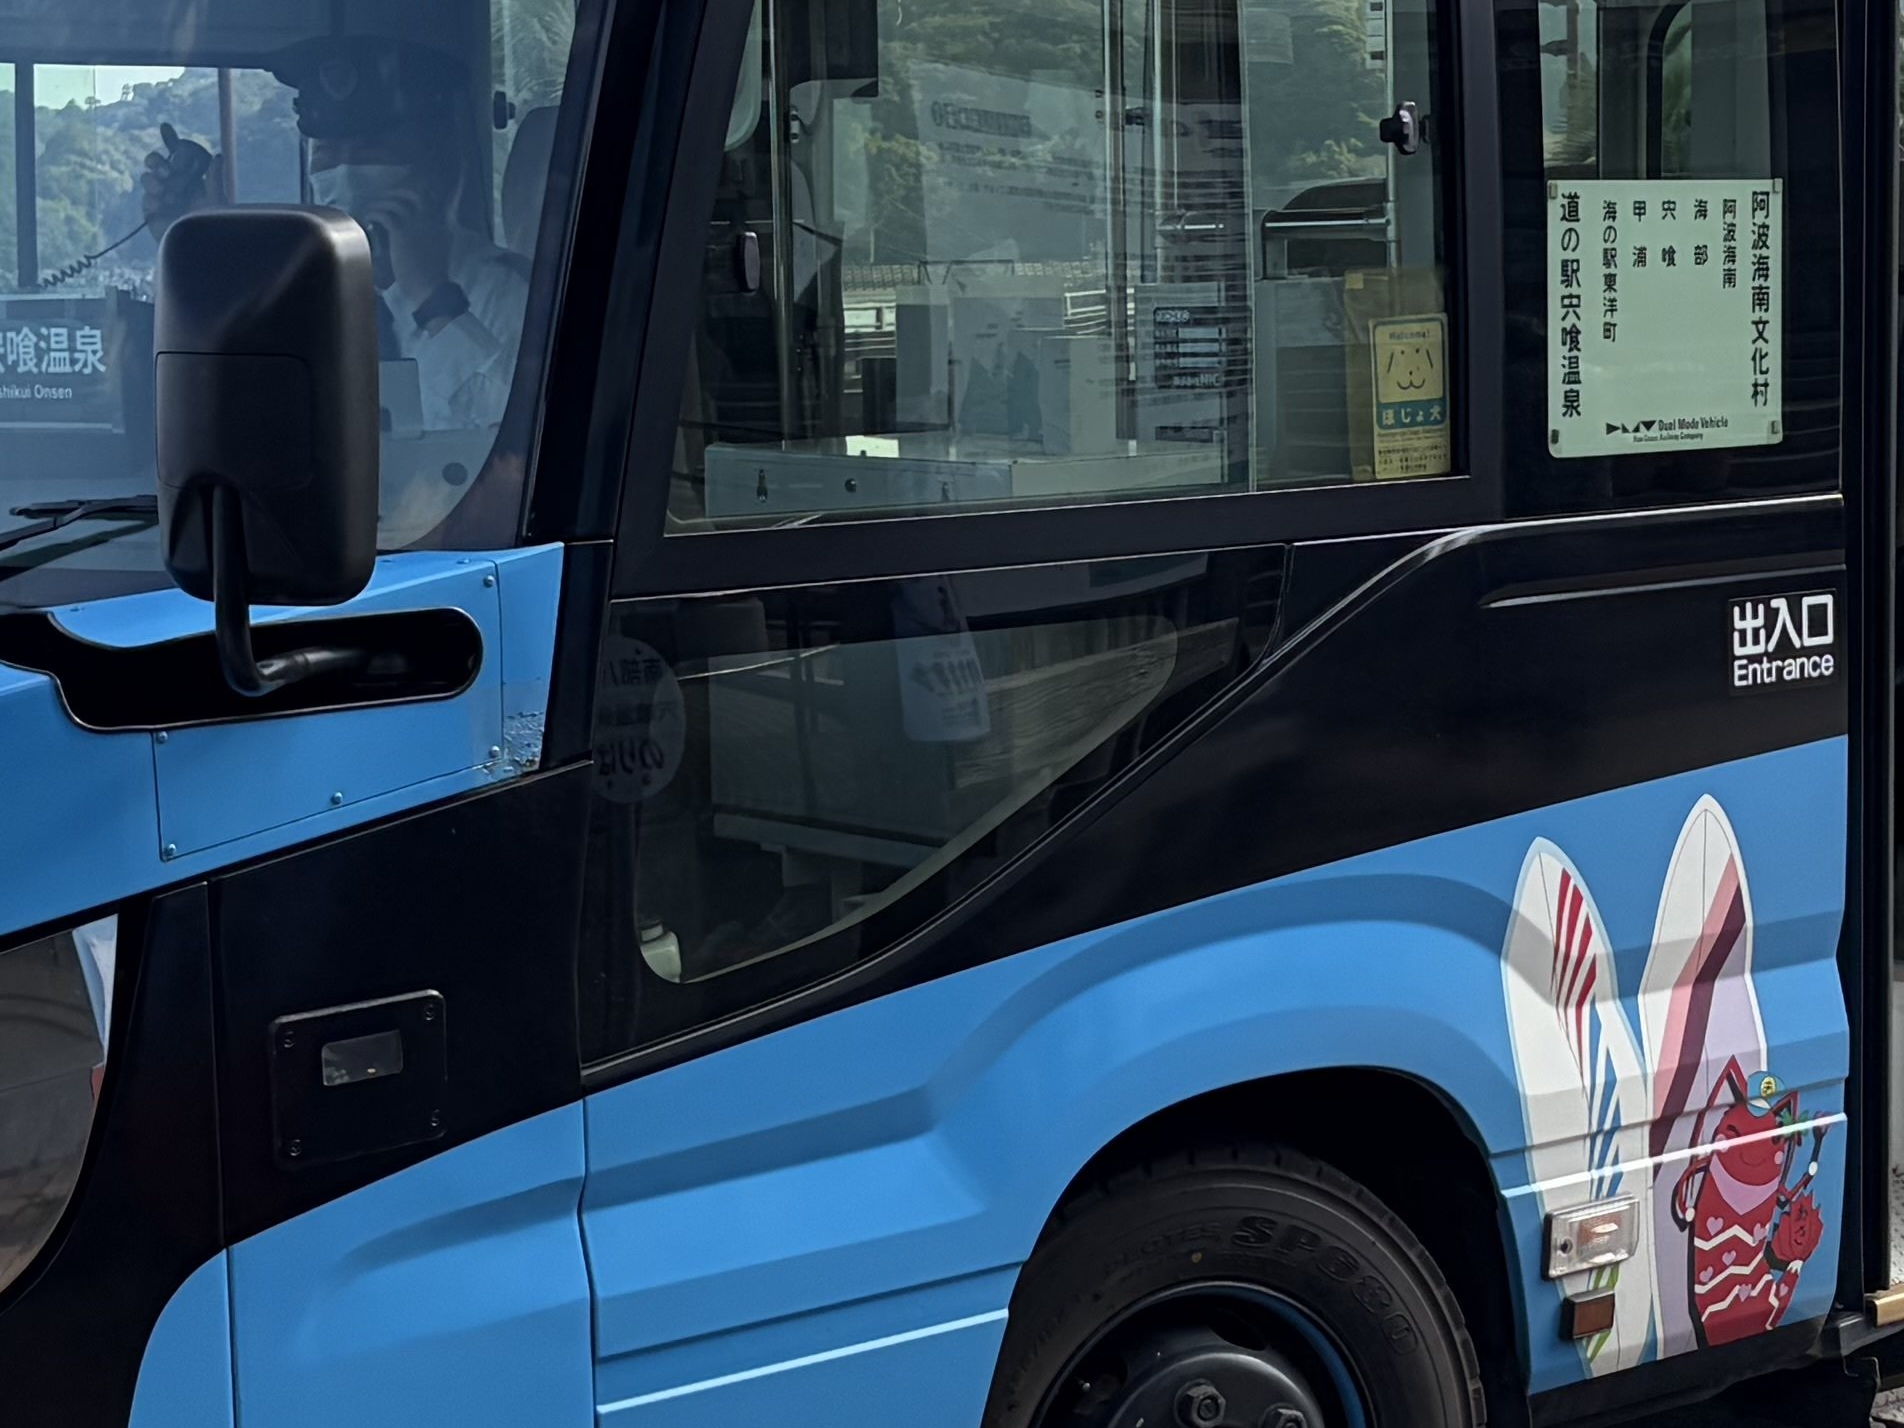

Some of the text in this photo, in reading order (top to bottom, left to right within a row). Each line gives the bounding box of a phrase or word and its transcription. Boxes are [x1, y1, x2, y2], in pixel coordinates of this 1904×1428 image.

[1632, 200, 1647, 268] 甲浦
[1661, 199, 1676, 267] 宍喰
[1722, 198, 1737, 289] 阿波海南
[1560, 192, 1582, 418] 道の駅宍喰温泉
[1602, 200, 1618, 343] 海の駅東洋町
[1751, 190, 1770, 408] 阿波海南文化村
[34, 384, 73, 399] Onsen
[1733, 593, 1834, 657] 出入口
[1733, 653, 1834, 687] Entrance
